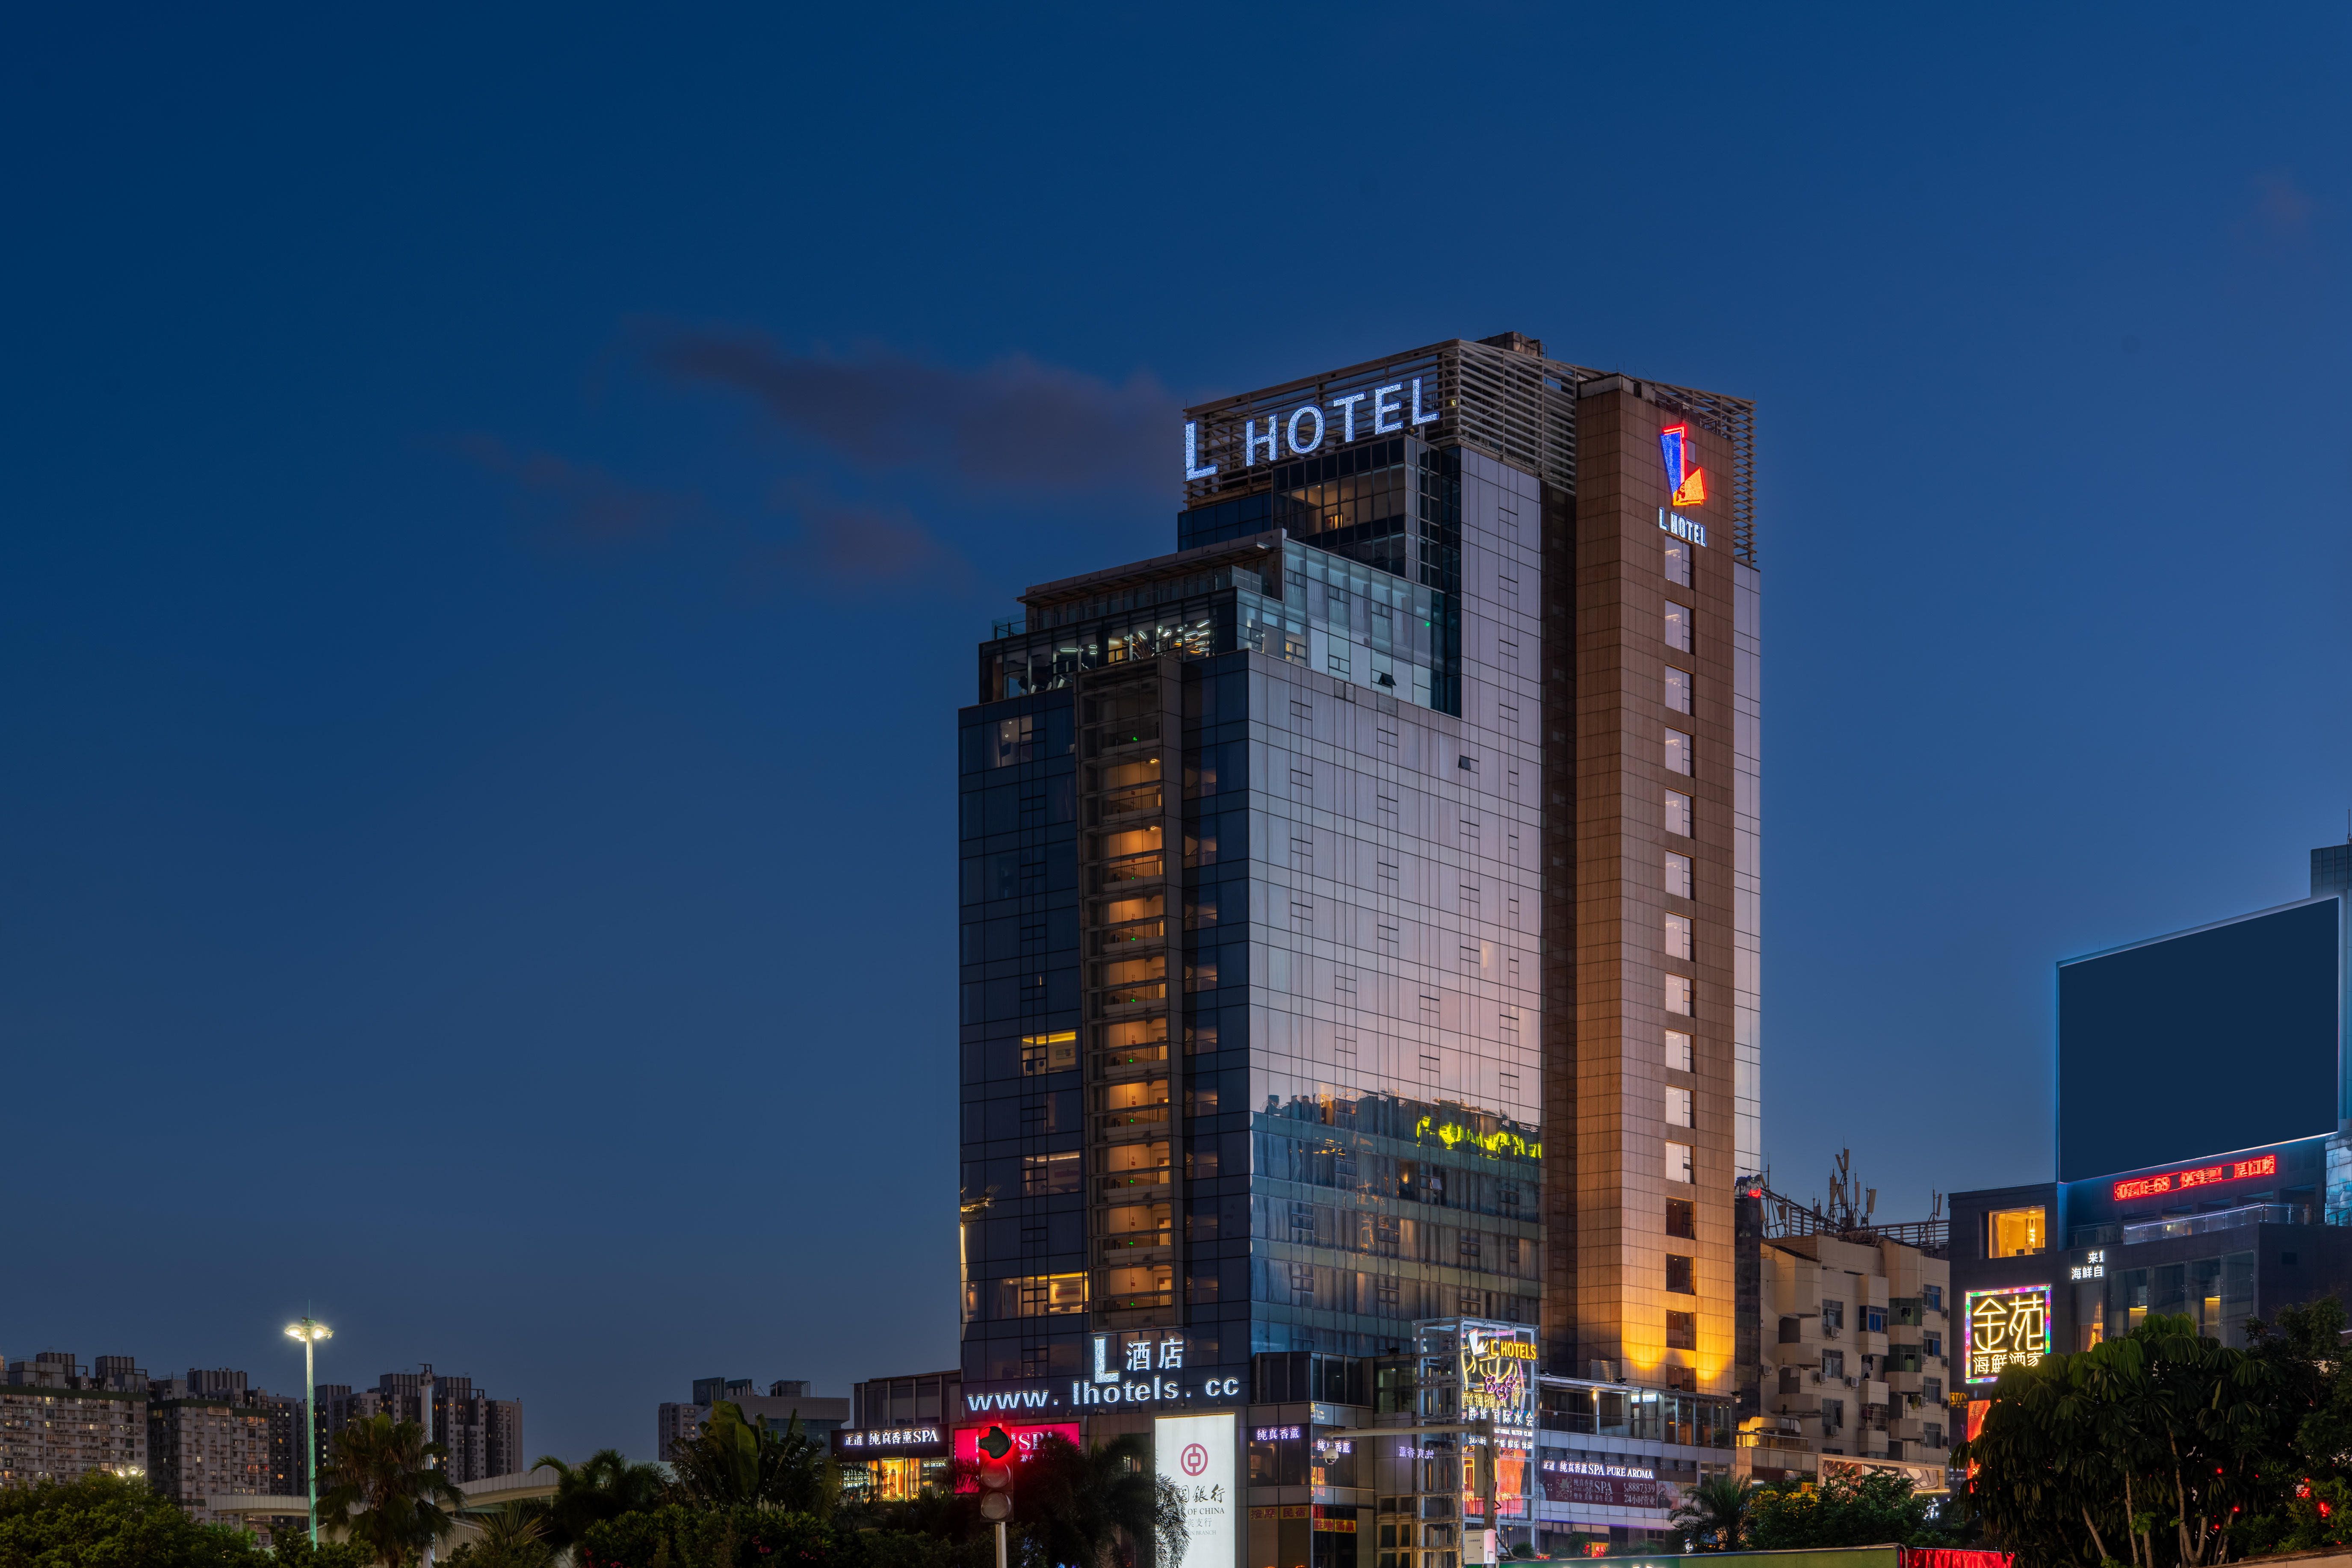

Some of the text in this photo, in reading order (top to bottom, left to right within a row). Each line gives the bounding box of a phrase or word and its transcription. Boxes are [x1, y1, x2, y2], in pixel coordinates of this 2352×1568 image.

[1185, 377, 1439, 481] L HOTEL
[1659, 507, 1707, 547] L HOTEL
[2071, 1264, 2104, 1280] 海鲜自
[1973, 1293, 2044, 1355] 金苑
[1501, 1341, 1537, 1360] HOTELS
[1094, 1336, 1184, 1383] L 酒店
[845, 1432, 863, 1445] 正道
[1317, 1438, 1350, 1453] 纯香薰
[1507, 1439, 1519, 1449] 娱乐
[1522, 1440, 1534, 1450] 休闲
[1543, 1460, 1555, 1471] 正道
[1606, 1465, 1626, 1476] PURE
[1627, 1468, 1654, 1479] AROMA
[1179, 1483, 1226, 1503] 國銀行
[1594, 1481, 1613, 1494] SPA
[1628, 1482, 1655, 1493] 8887339
[1624, 1494, 1655, 1505] 24小时营业
[1250, 1508, 1277, 1520] 按摩
[1283, 1507, 1306, 1518] 民宿
[1186, 1518, 1212, 1528] 宾支行
[1336, 1521, 1355, 1532] 汤泉
